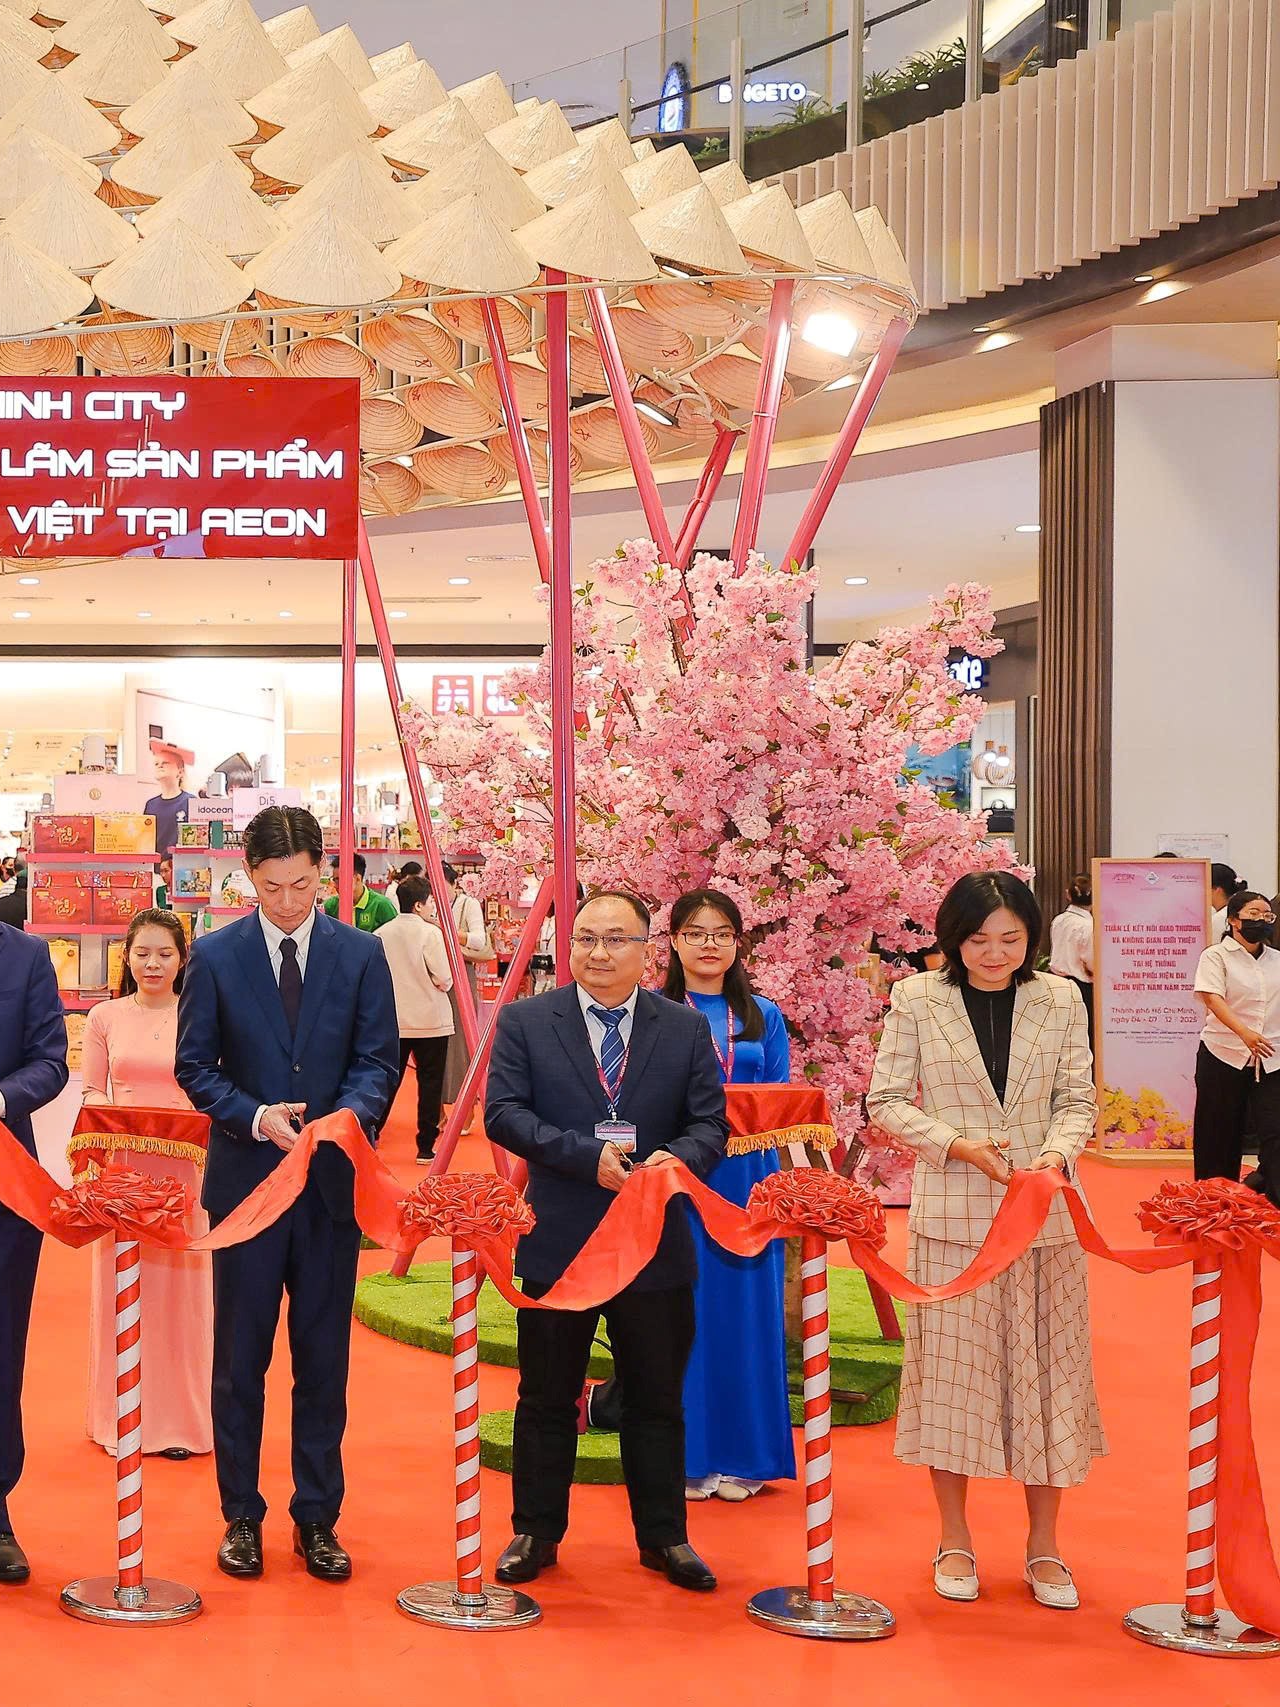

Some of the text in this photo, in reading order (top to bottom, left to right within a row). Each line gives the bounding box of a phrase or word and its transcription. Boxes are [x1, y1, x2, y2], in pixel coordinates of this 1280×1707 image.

[84, 391, 186, 420] CITY
[0, 441, 94, 478] LÃM
[106, 441, 200, 479] SẢN
[212, 438, 344, 479] PHẨM
[7, 500, 104, 542] VIỆT
[117, 506, 188, 540] TẠI
[200, 508, 327, 537] AEON
